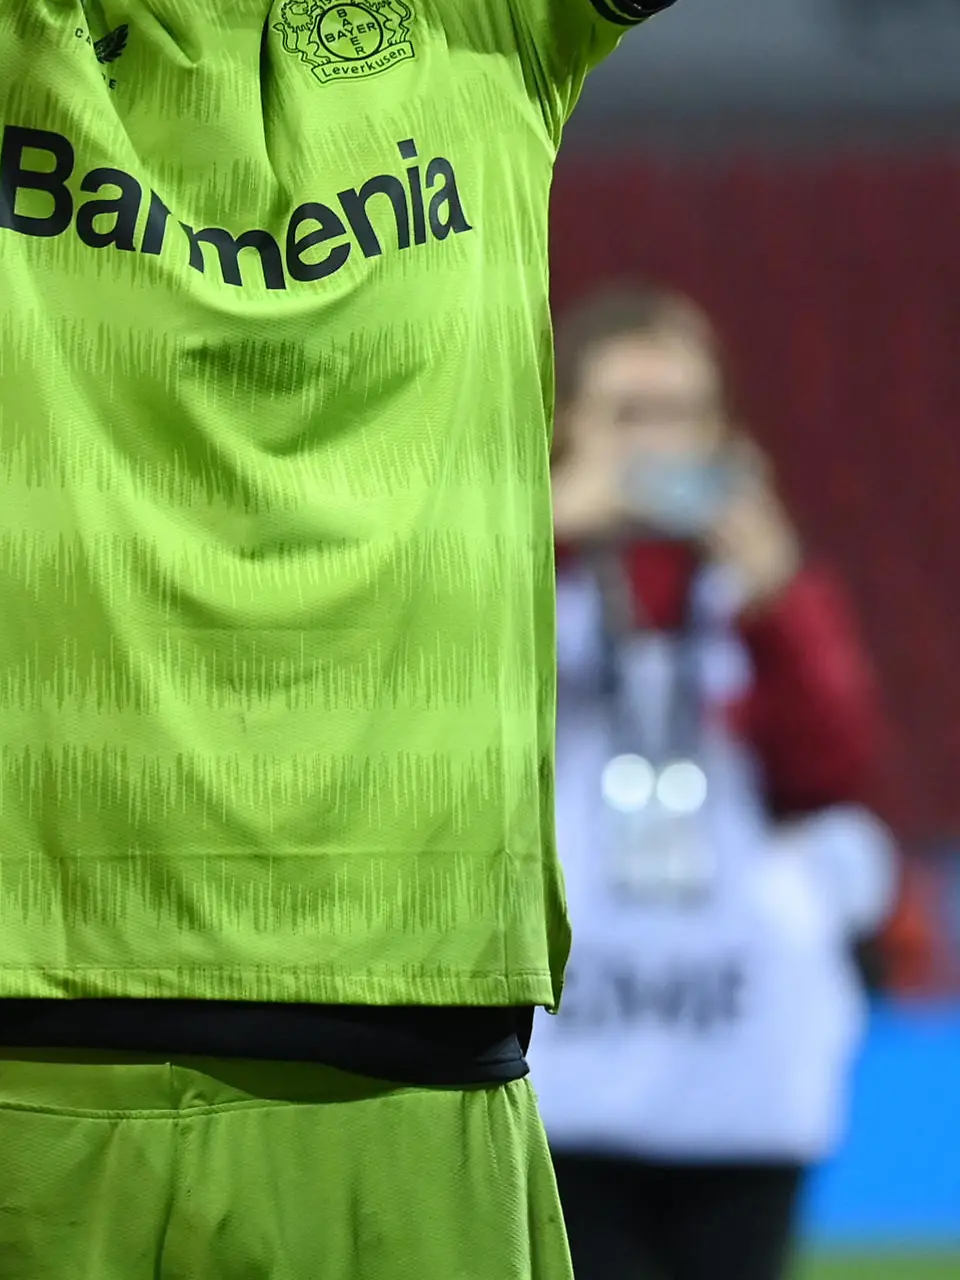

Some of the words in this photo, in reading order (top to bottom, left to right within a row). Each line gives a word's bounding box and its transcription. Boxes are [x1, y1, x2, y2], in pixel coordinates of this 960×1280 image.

[324, 22, 378, 44] BAYER
[336, 8, 367, 56] BAYER
[321, 46, 407, 78] Leverkusen
